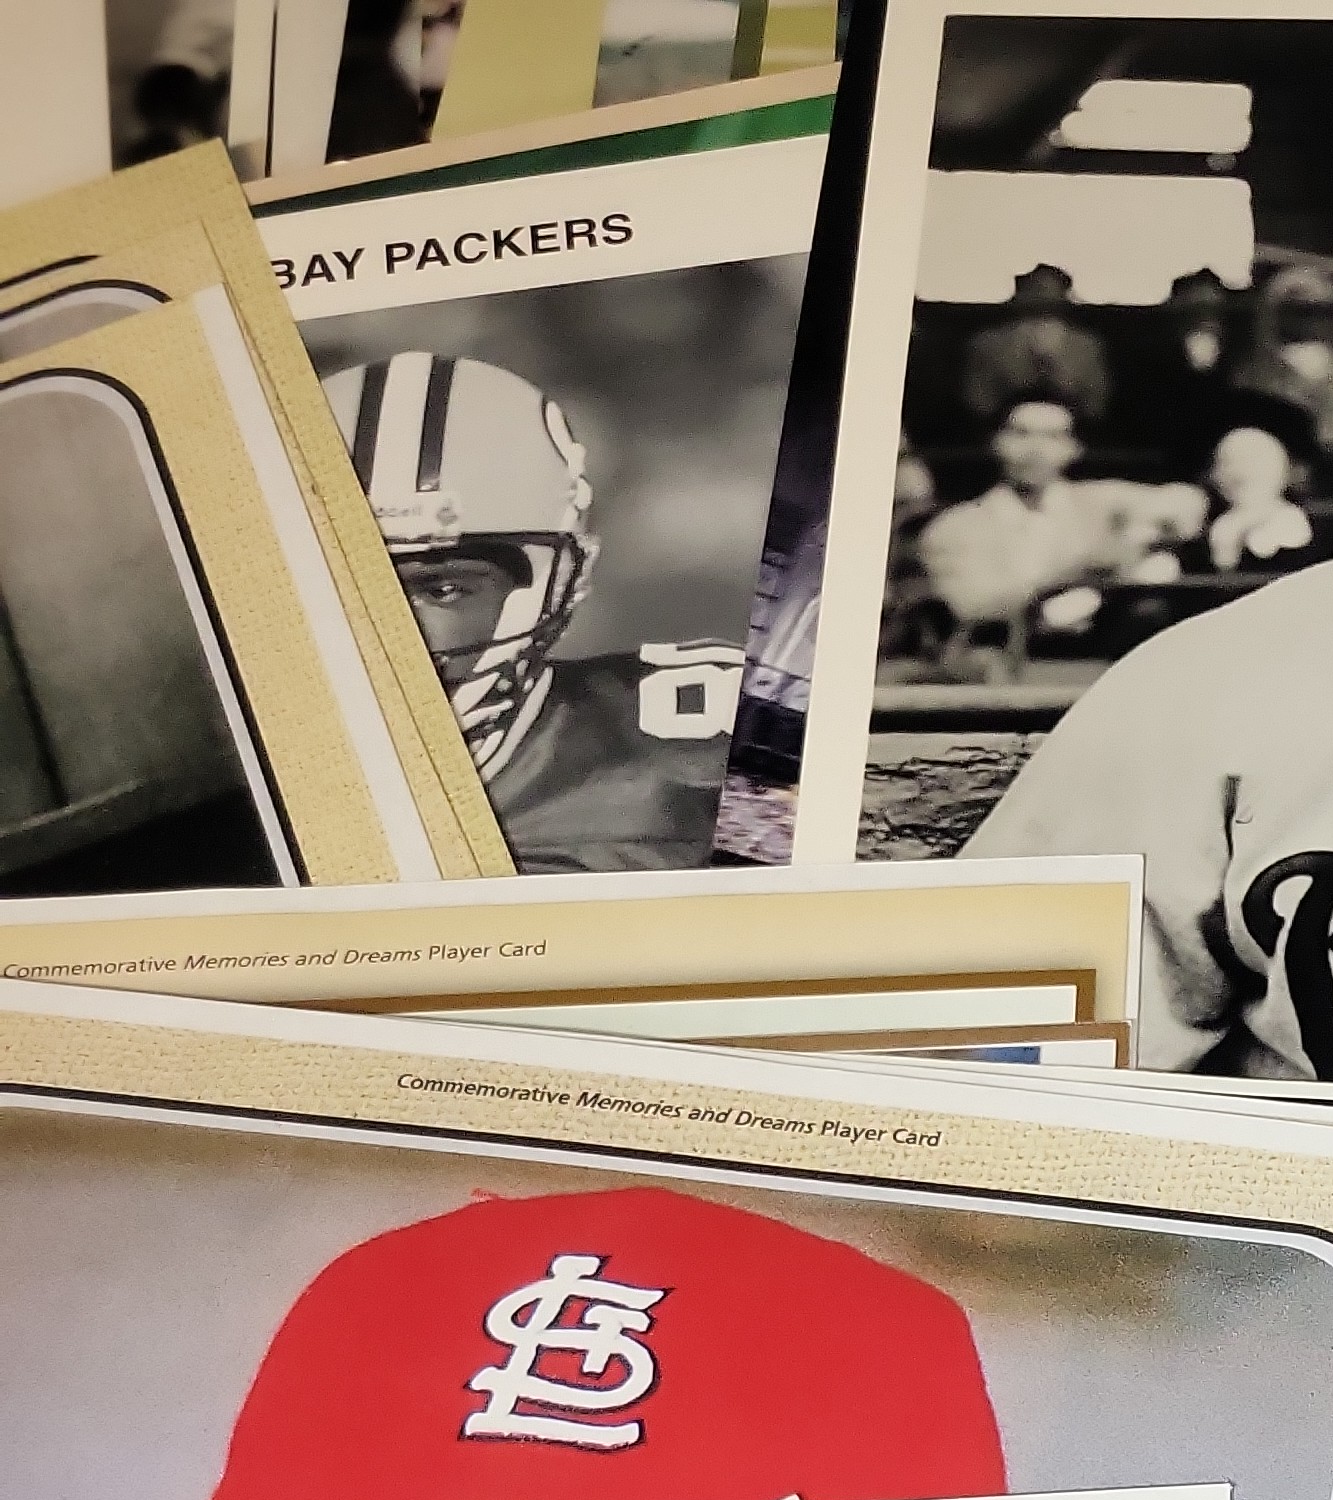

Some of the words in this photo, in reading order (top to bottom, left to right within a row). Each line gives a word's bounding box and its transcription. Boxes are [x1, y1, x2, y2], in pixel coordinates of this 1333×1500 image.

[270, 246, 365, 290] BAY
[384, 212, 636, 275] PACKERS
[2, 954, 177, 979] Commemorative
[183, 949, 288, 971] Memories
[294, 948, 337, 966] and
[343, 946, 422, 965] Dreams
[427, 942, 492, 963] Player
[498, 939, 548, 958] Card
[397, 1073, 570, 1107] Commemorative
[576, 1091, 681, 1119] Memories
[687, 1104, 731, 1125] and
[734, 1109, 817, 1136] Dreams
[820, 1119, 888, 1145] Player
[892, 1127, 943, 1148] Card
